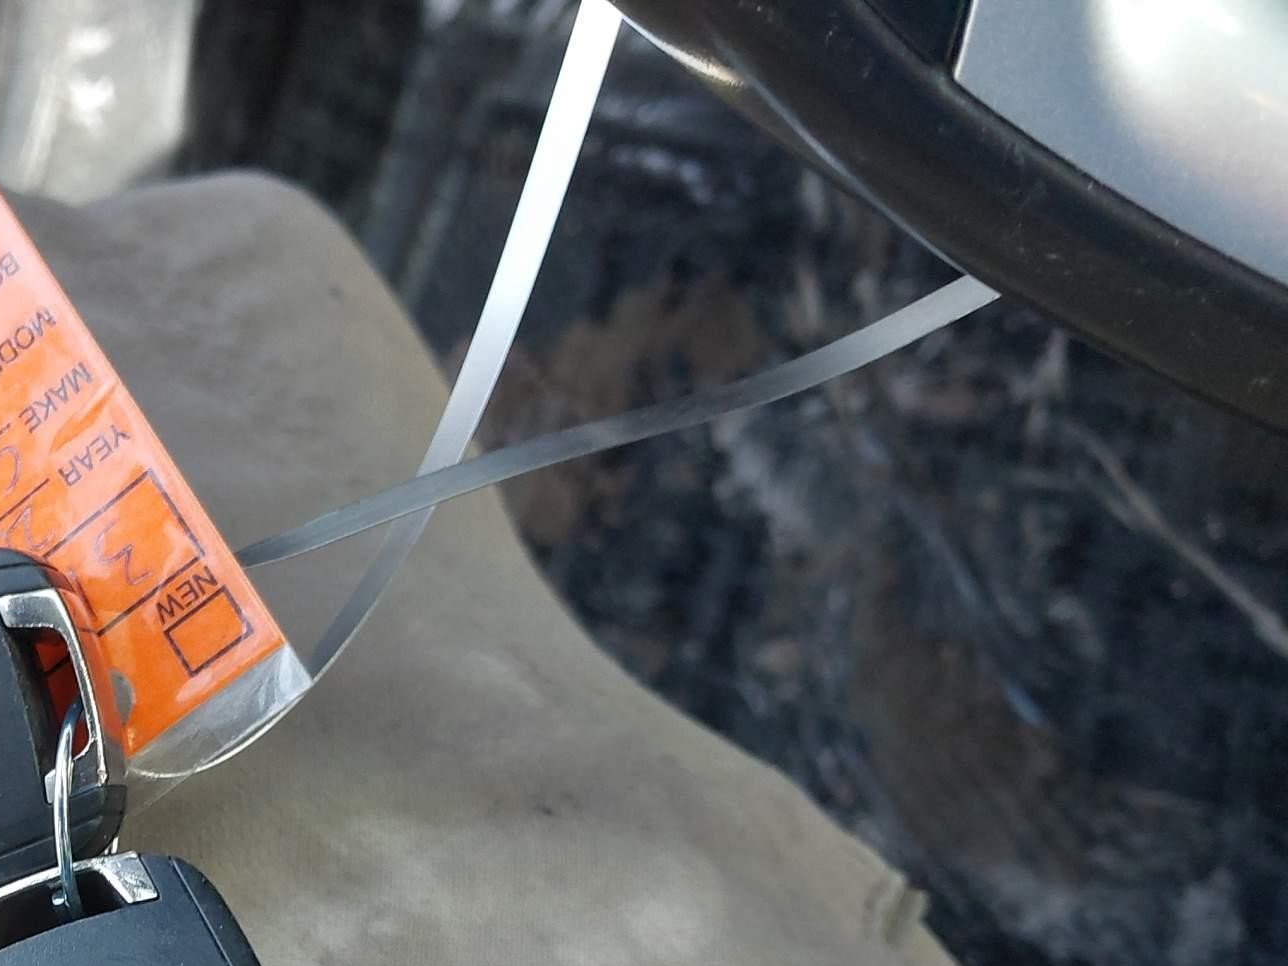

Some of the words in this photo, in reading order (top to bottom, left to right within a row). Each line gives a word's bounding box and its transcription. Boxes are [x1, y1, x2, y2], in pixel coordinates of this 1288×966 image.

[18, 362, 93, 434] MAKE
[58, 425, 131, 487] YEAR
[155, 566, 218, 625] NEW
